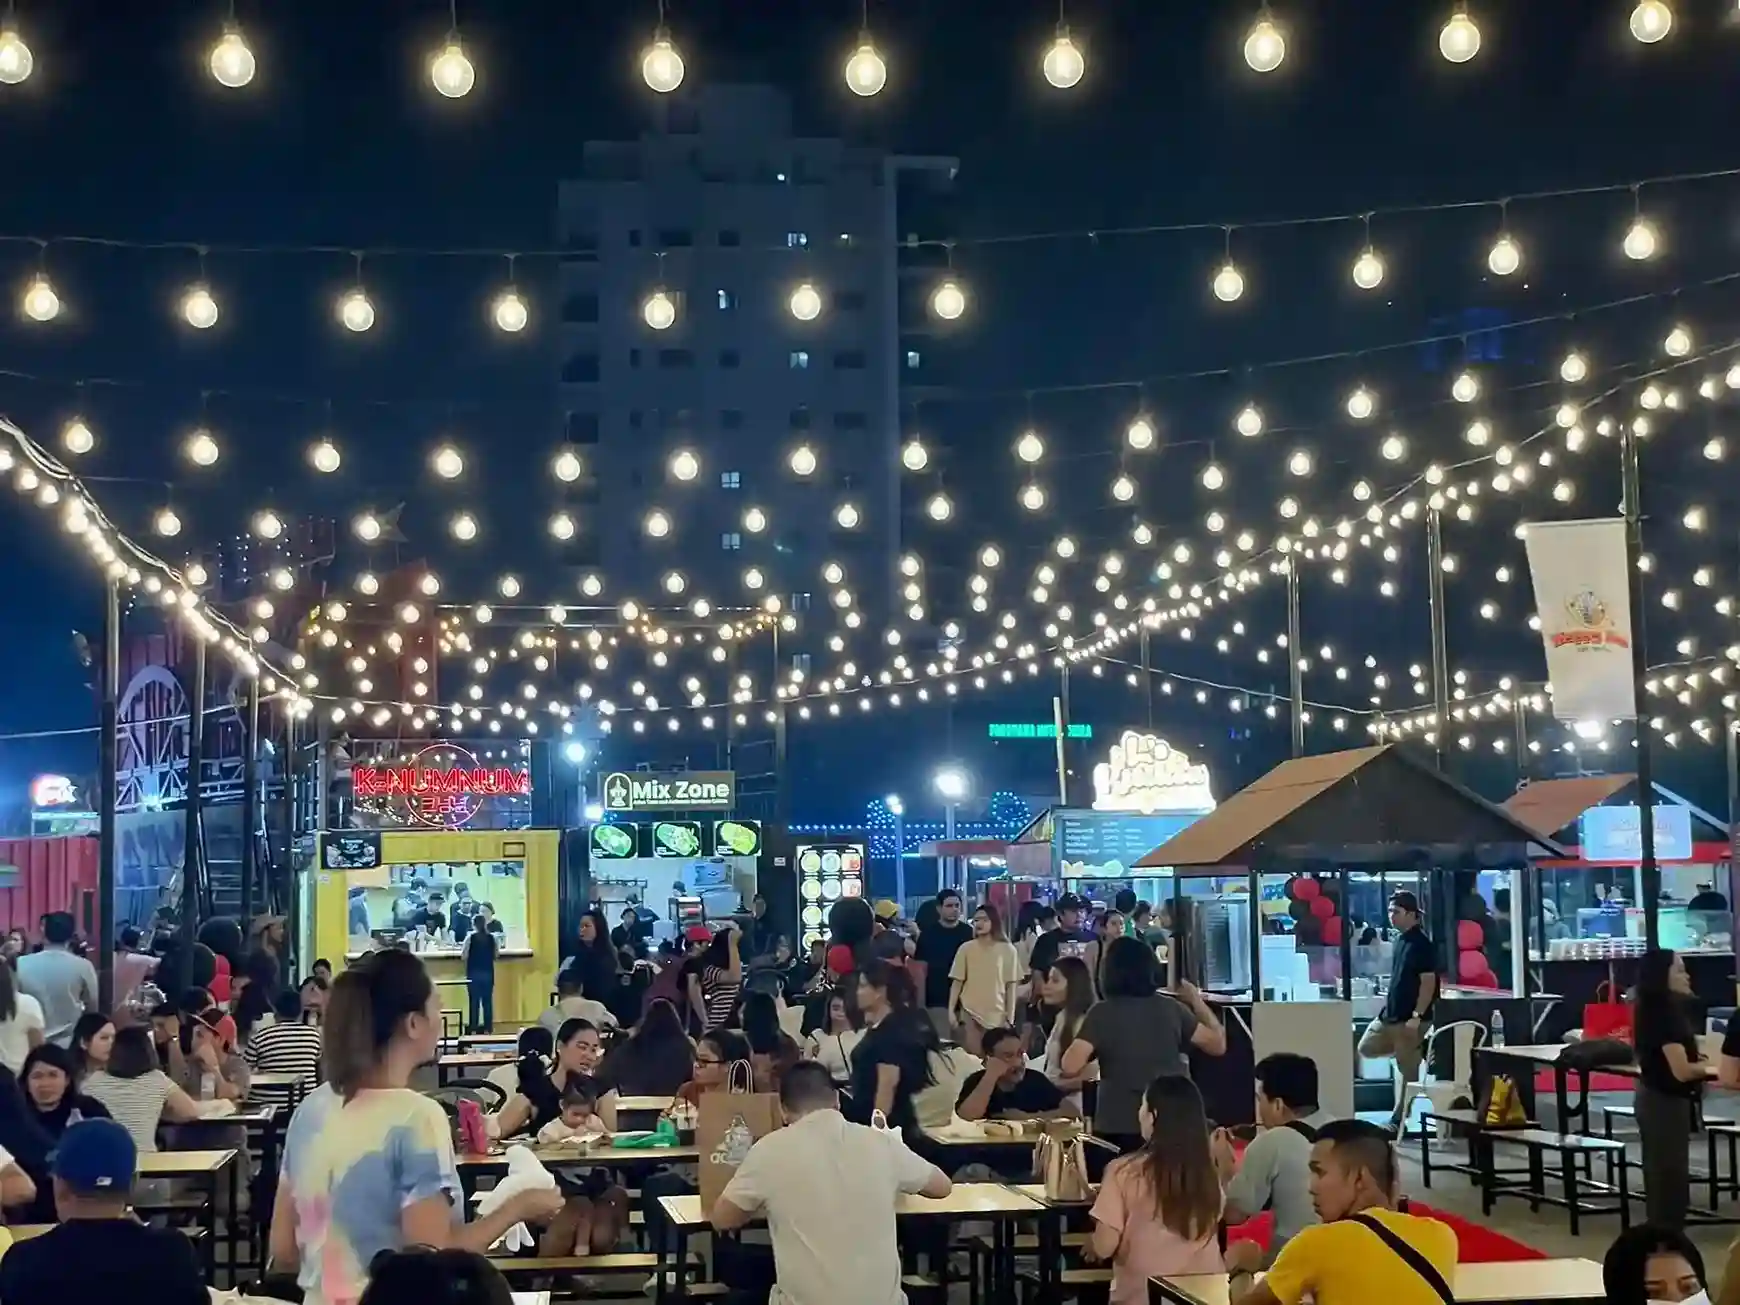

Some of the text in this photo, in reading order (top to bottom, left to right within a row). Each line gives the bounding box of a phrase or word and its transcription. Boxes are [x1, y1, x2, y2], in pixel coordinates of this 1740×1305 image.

[355, 768, 529, 795] K-NUMNUM
[633, 780, 730, 799] Mix Zone
